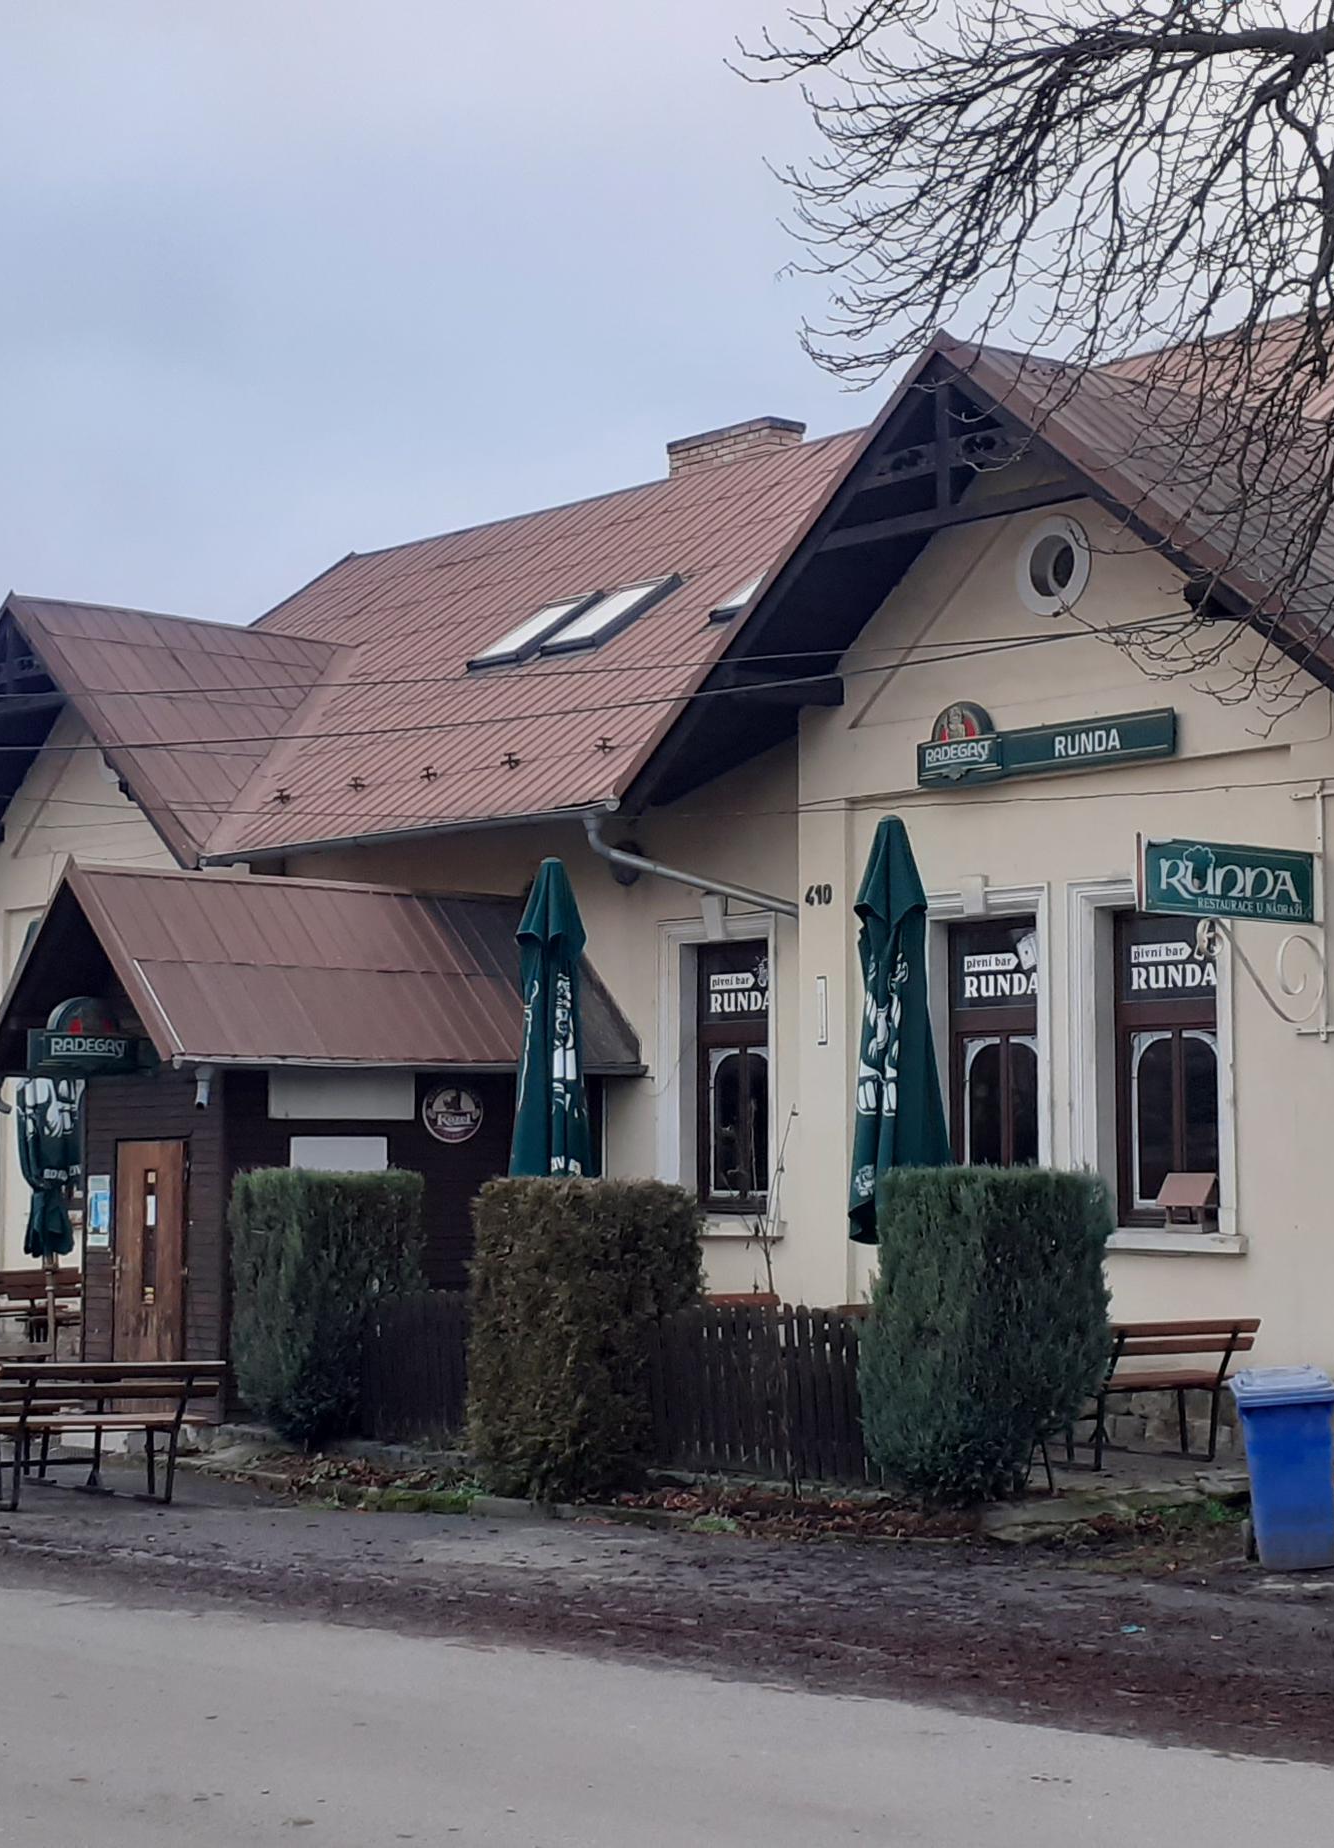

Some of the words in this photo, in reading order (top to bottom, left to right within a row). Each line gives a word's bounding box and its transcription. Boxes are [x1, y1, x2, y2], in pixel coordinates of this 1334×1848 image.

[925, 740, 992, 768] RADEGAST
[1054, 728, 1121, 758] RUNDA
[1159, 852, 1303, 903] RUNDA
[805, 884, 832, 906] 410
[1197, 897, 1254, 913] RESTAURACE
[1256, 902, 1264, 914] U
[966, 955, 992, 970] pivní
[994, 956, 1012, 967] bar
[1133, 945, 1162, 961] pivní
[1165, 946, 1185, 957] bar
[735, 976, 750, 986] bar
[964, 972, 1039, 998] RUNDA
[1131, 962, 1217, 990] RUNDA
[50, 1036, 127, 1059] RADEGAST
